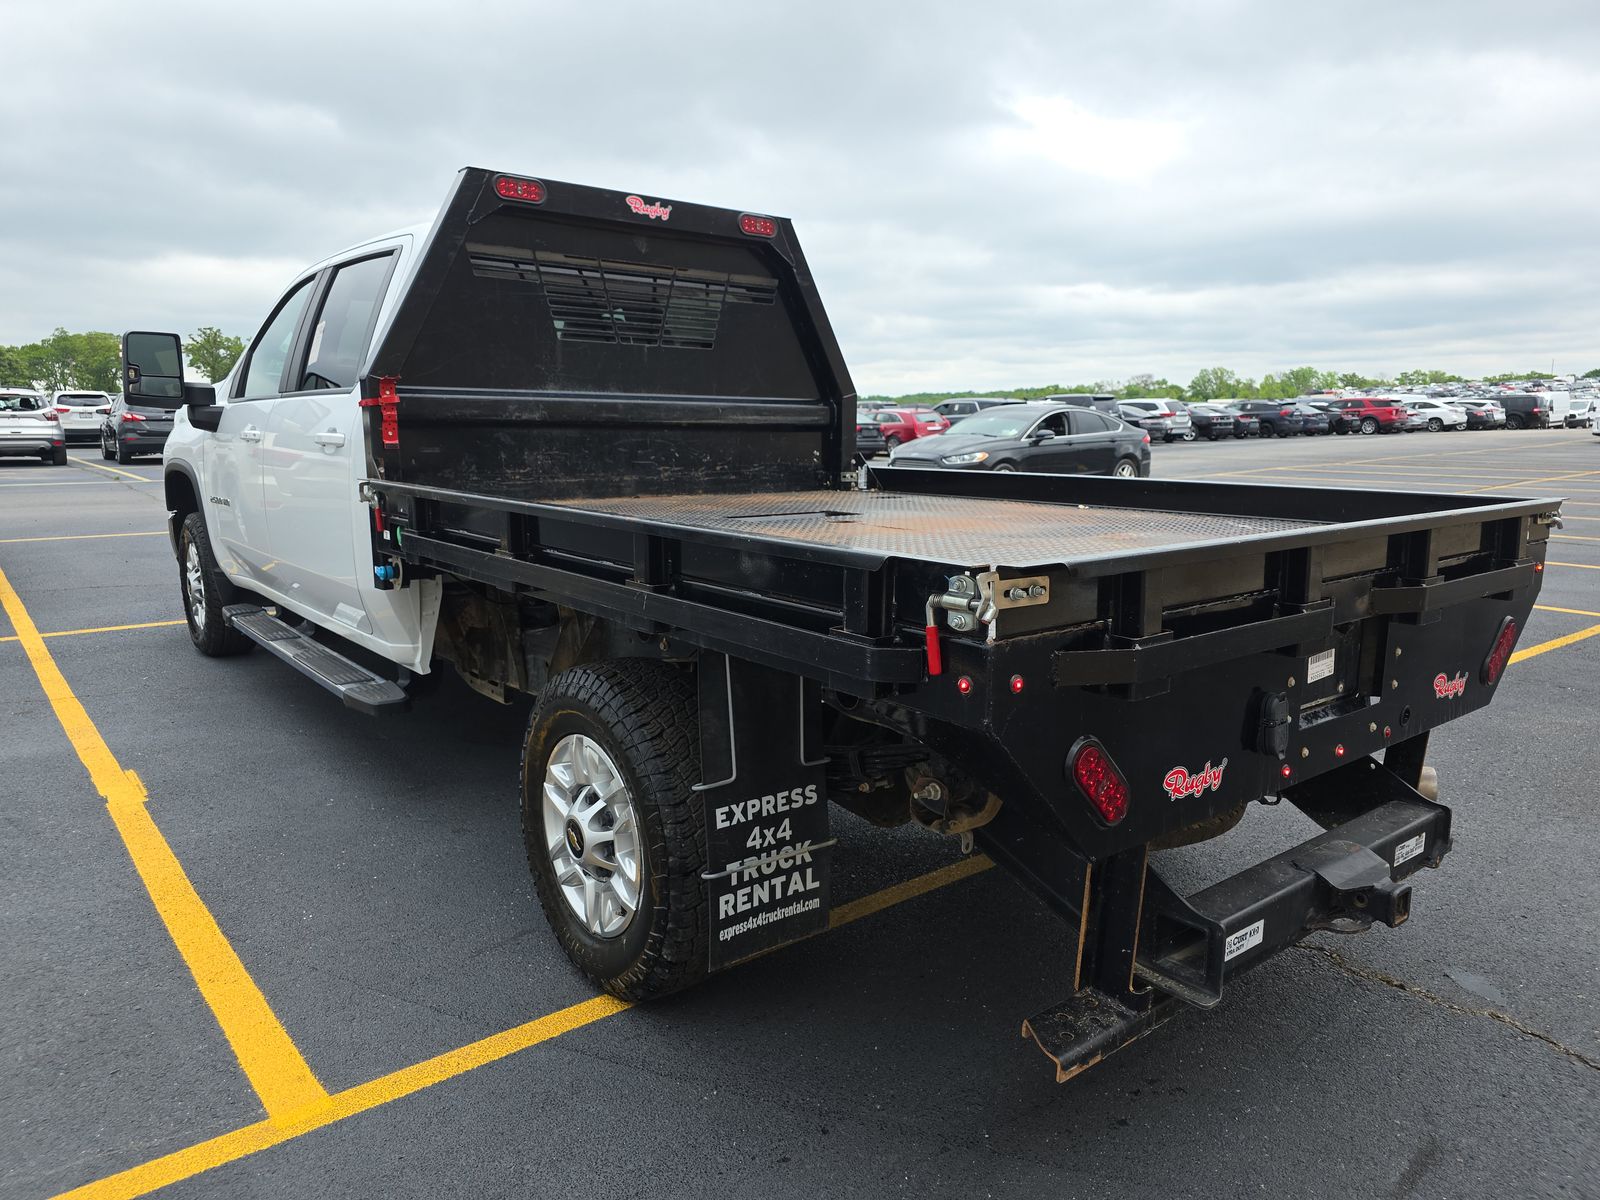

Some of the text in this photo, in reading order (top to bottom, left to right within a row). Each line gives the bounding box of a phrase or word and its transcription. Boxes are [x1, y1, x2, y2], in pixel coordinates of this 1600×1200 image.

[626, 195, 672, 220] Rugby
[1434, 670, 1469, 699] Rugby
[1163, 757, 1229, 801] Rugby
[715, 784, 818, 830] EXPRESS
[746, 818, 793, 850] 4x4
[726, 840, 813, 886] TRUCK
[719, 867, 820, 920] RENTAL
[719, 897, 820, 942] express4x4truckrental.com
